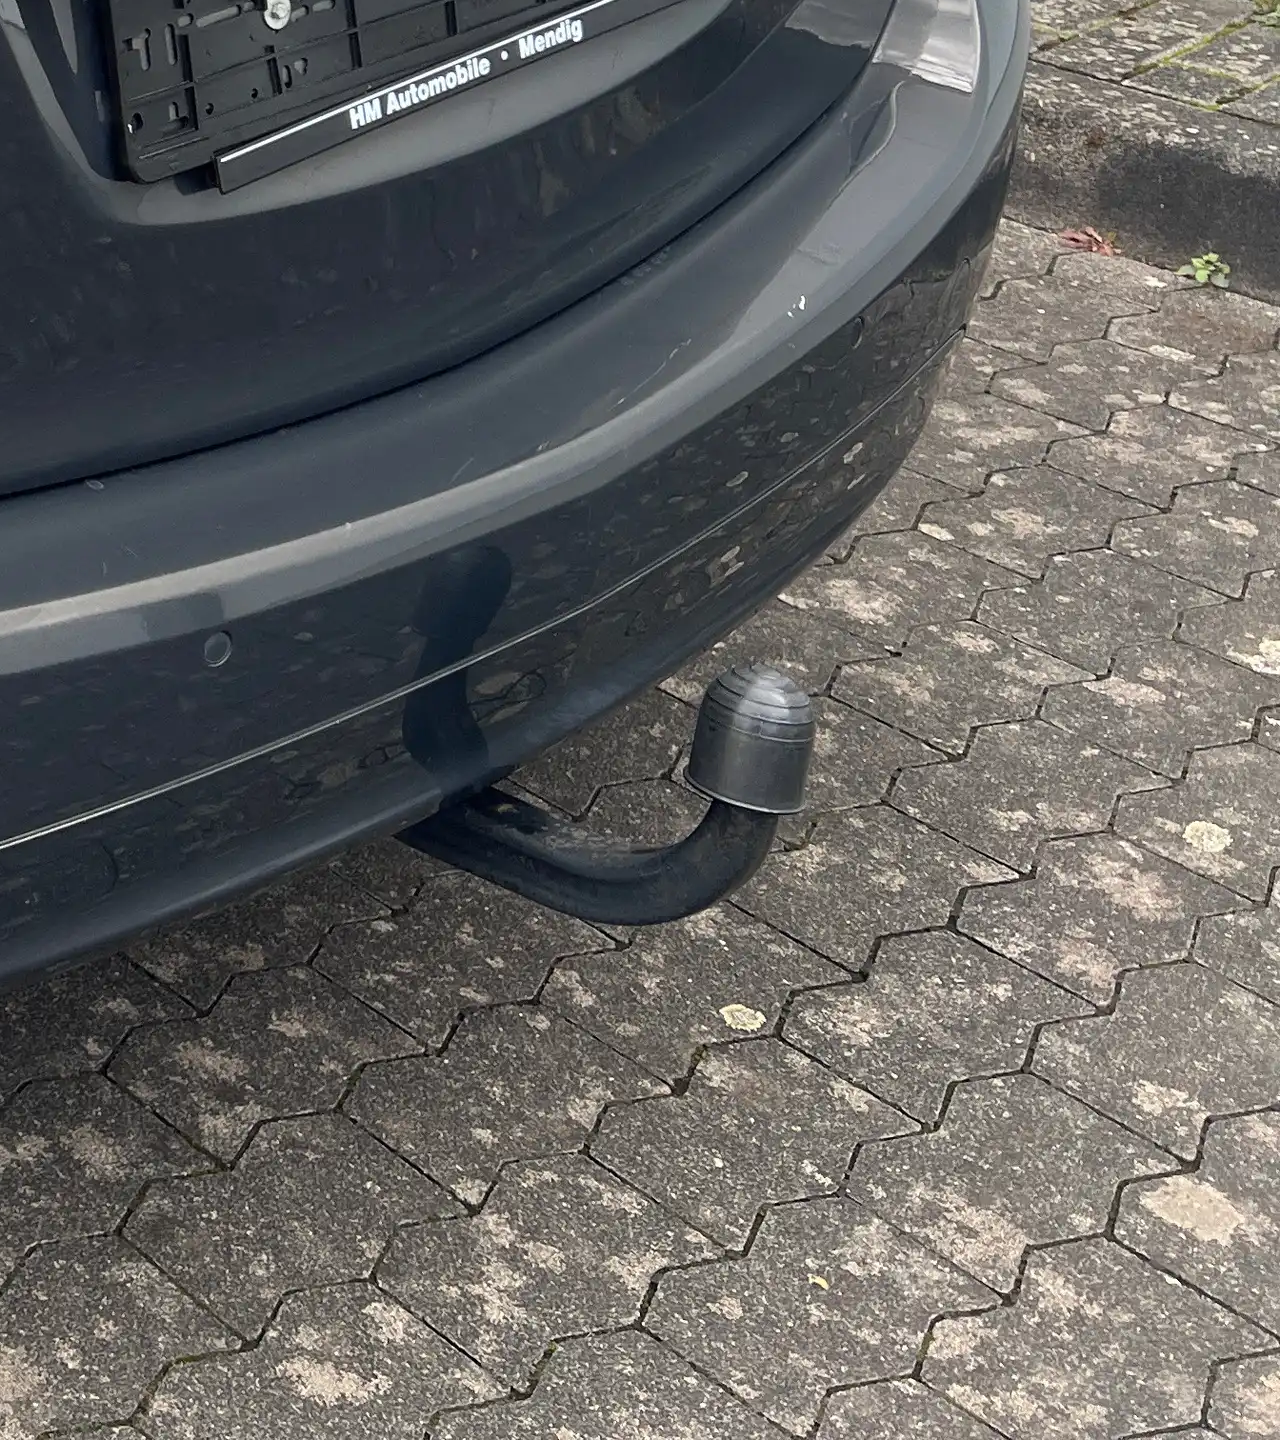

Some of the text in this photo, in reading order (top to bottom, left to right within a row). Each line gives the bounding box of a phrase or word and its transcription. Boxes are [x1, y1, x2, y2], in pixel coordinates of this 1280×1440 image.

[349, 18, 583, 130] HM Automobile Mendig
